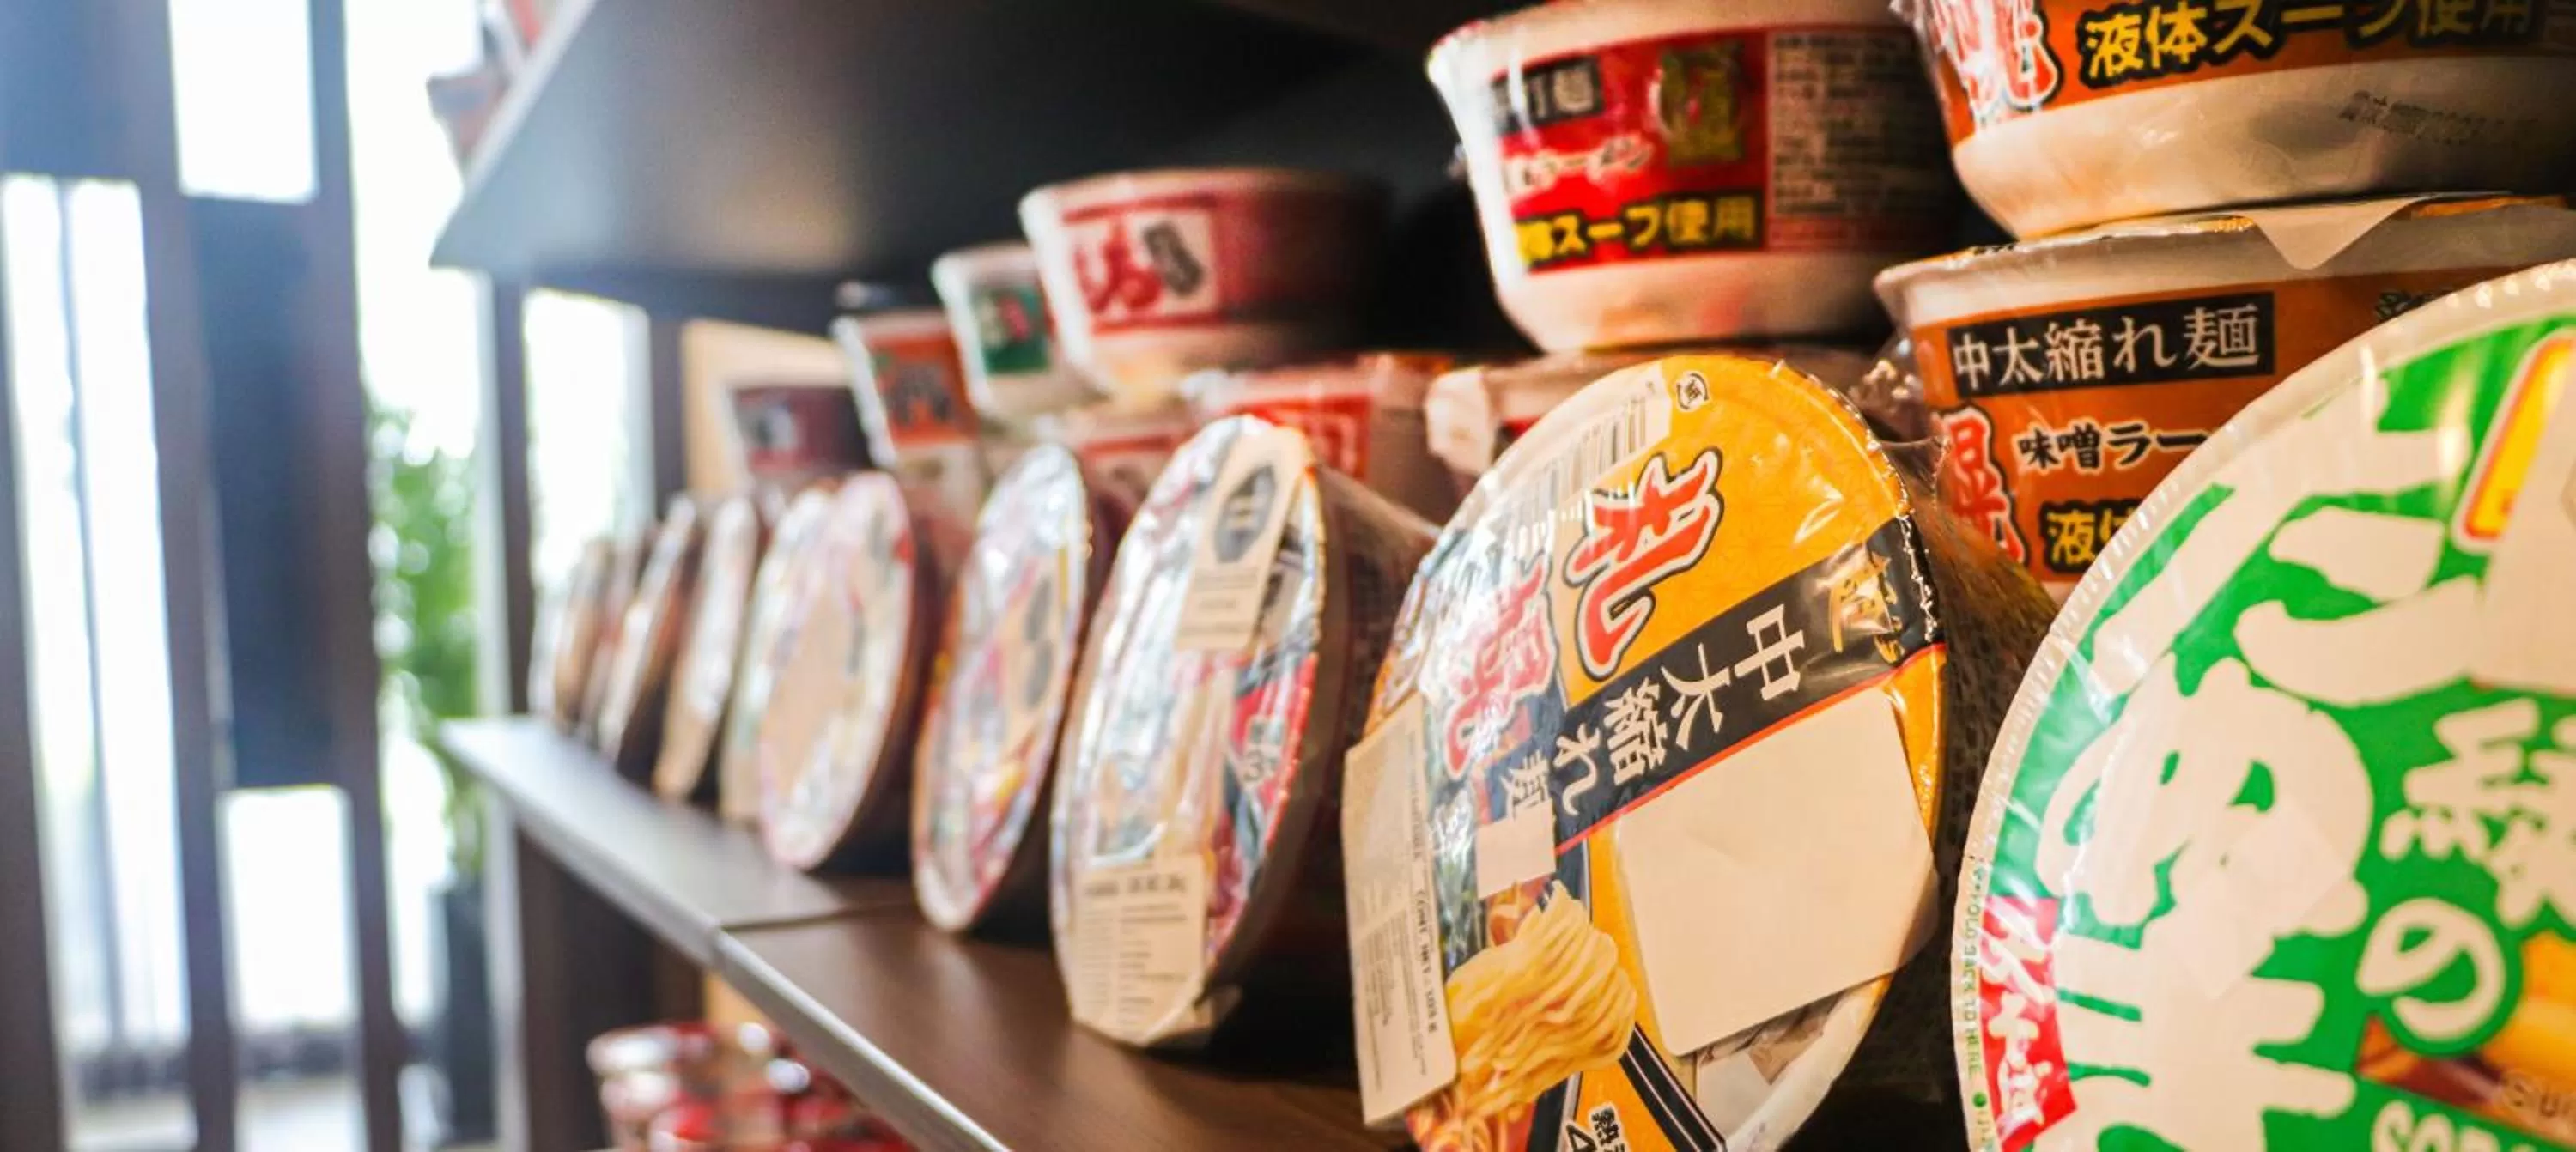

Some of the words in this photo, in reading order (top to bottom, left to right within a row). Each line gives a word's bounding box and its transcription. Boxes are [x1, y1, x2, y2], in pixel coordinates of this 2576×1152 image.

[1953, 305, 2260, 391] 中太縮れ麺
